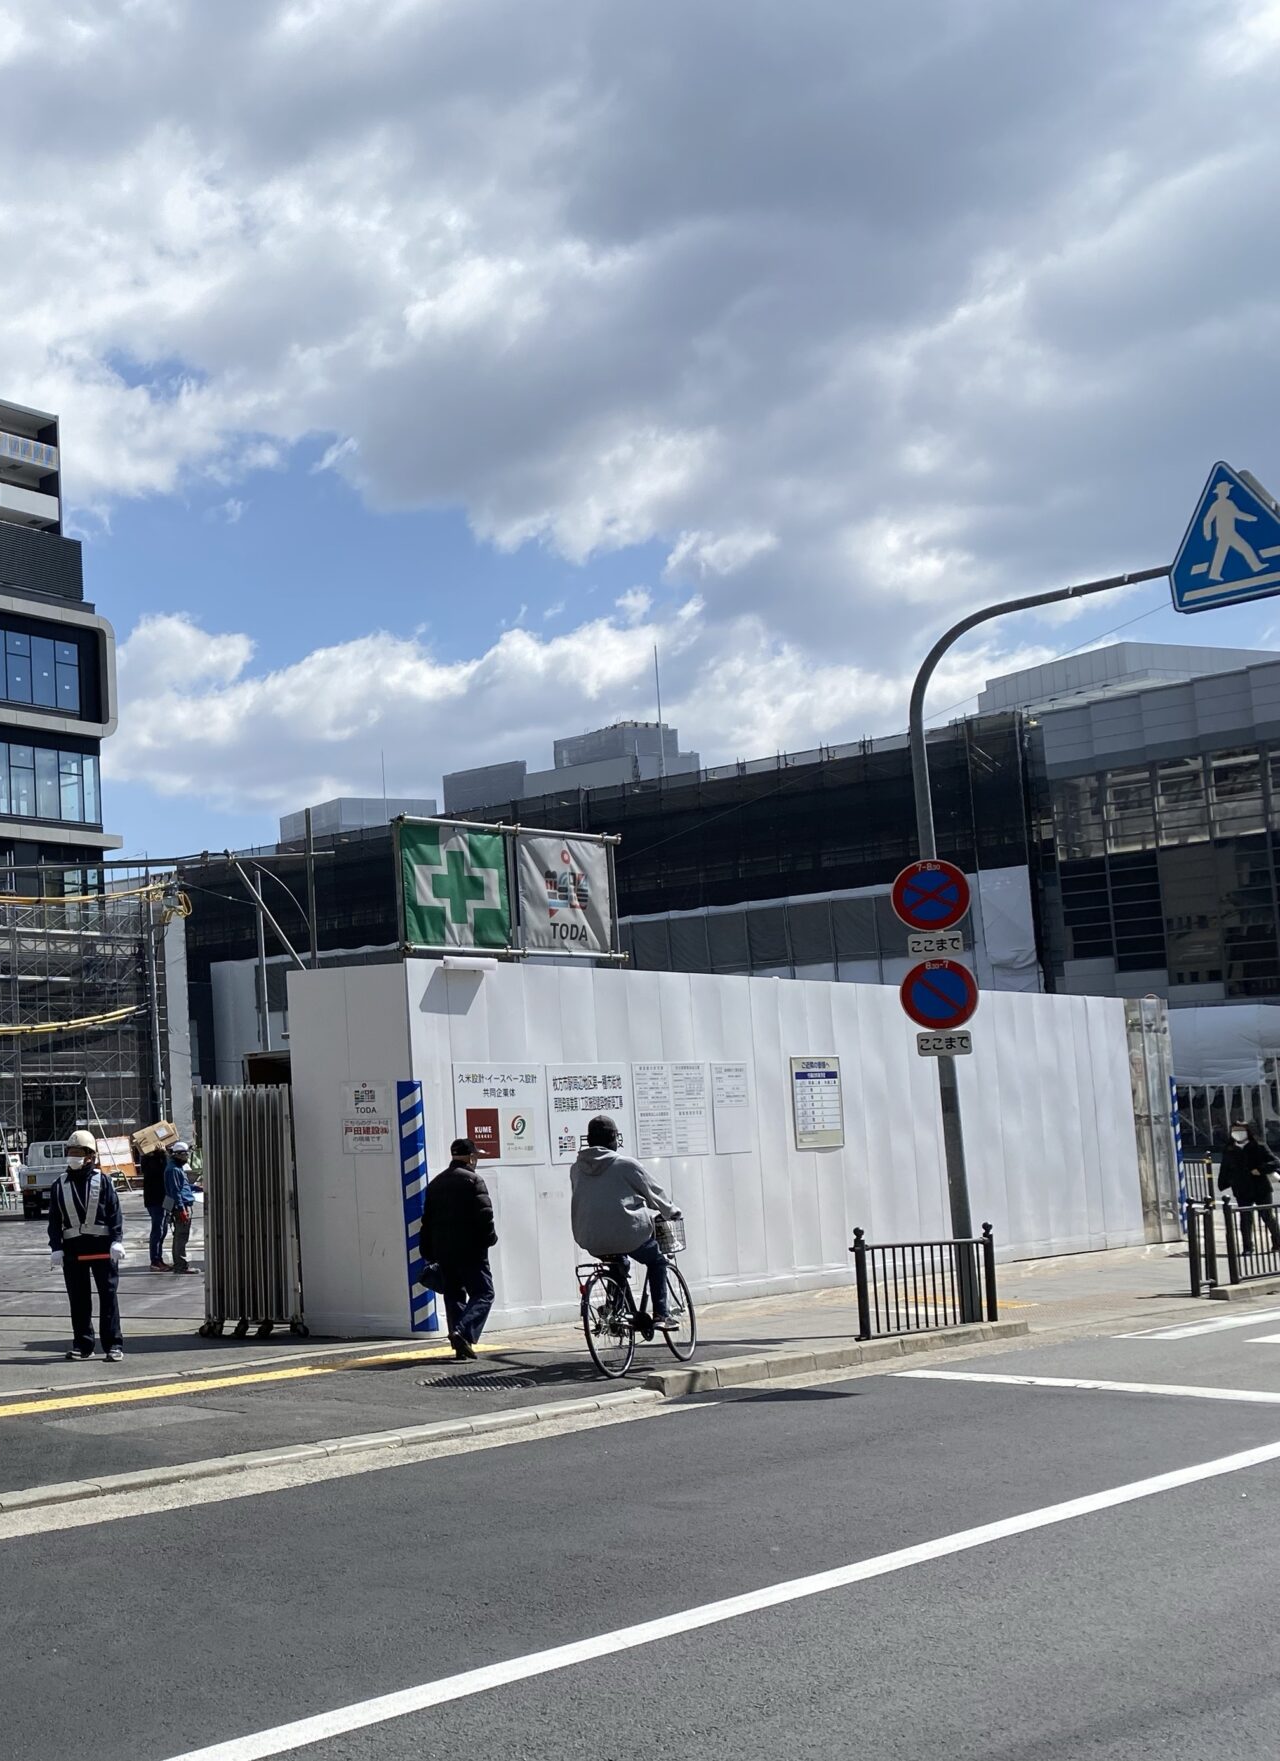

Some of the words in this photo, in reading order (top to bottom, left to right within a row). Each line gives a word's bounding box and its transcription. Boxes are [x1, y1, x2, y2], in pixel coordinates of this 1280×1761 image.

[550, 922, 588, 941] TODA
[911, 937, 960, 953] ここまで
[920, 1036, 970, 1051] ここまで
[483, 1087, 516, 1098] 共同企業体
[474, 1125, 492, 1133] KUME
